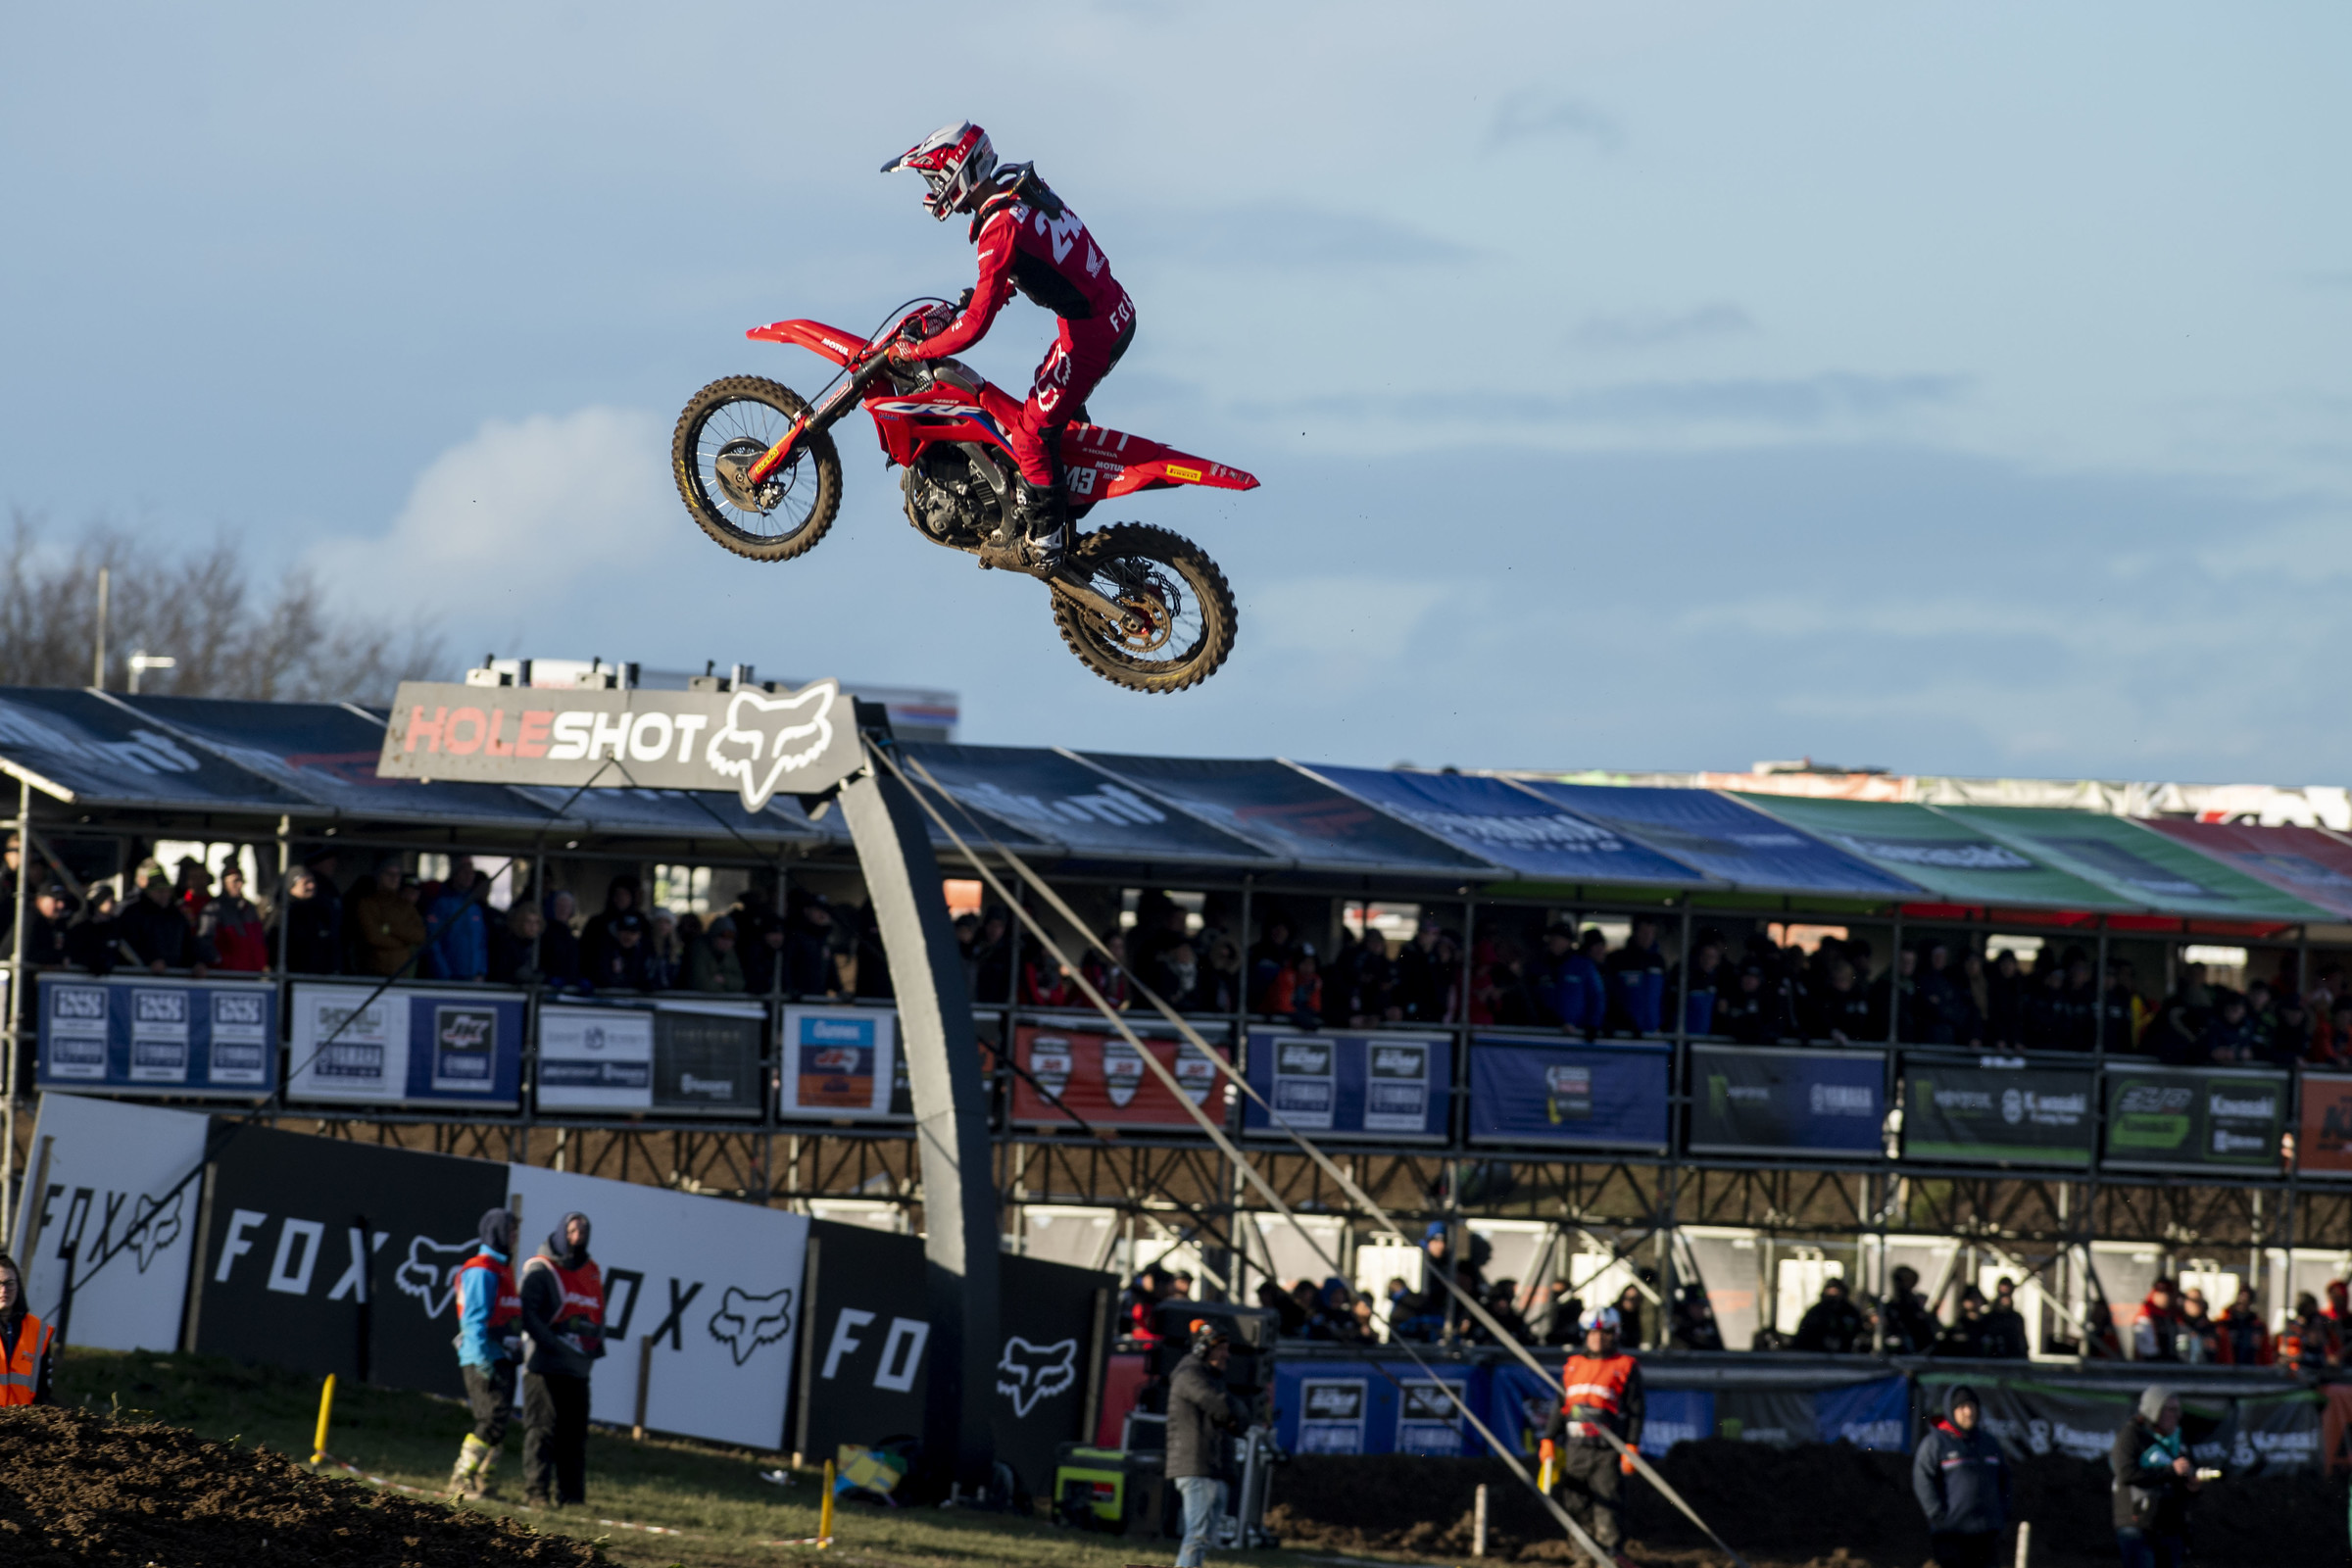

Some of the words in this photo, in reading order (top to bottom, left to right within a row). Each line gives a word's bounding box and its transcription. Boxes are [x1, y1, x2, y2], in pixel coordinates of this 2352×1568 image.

[821, 337, 849, 356] MOTUL
[1095, 461, 1125, 472] MOTUL
[1169, 467, 1199, 479] PIRELLI
[215, 1208, 389, 1303] FOX
[604, 1267, 704, 1350] OX
[821, 1307, 930, 1393] FO
